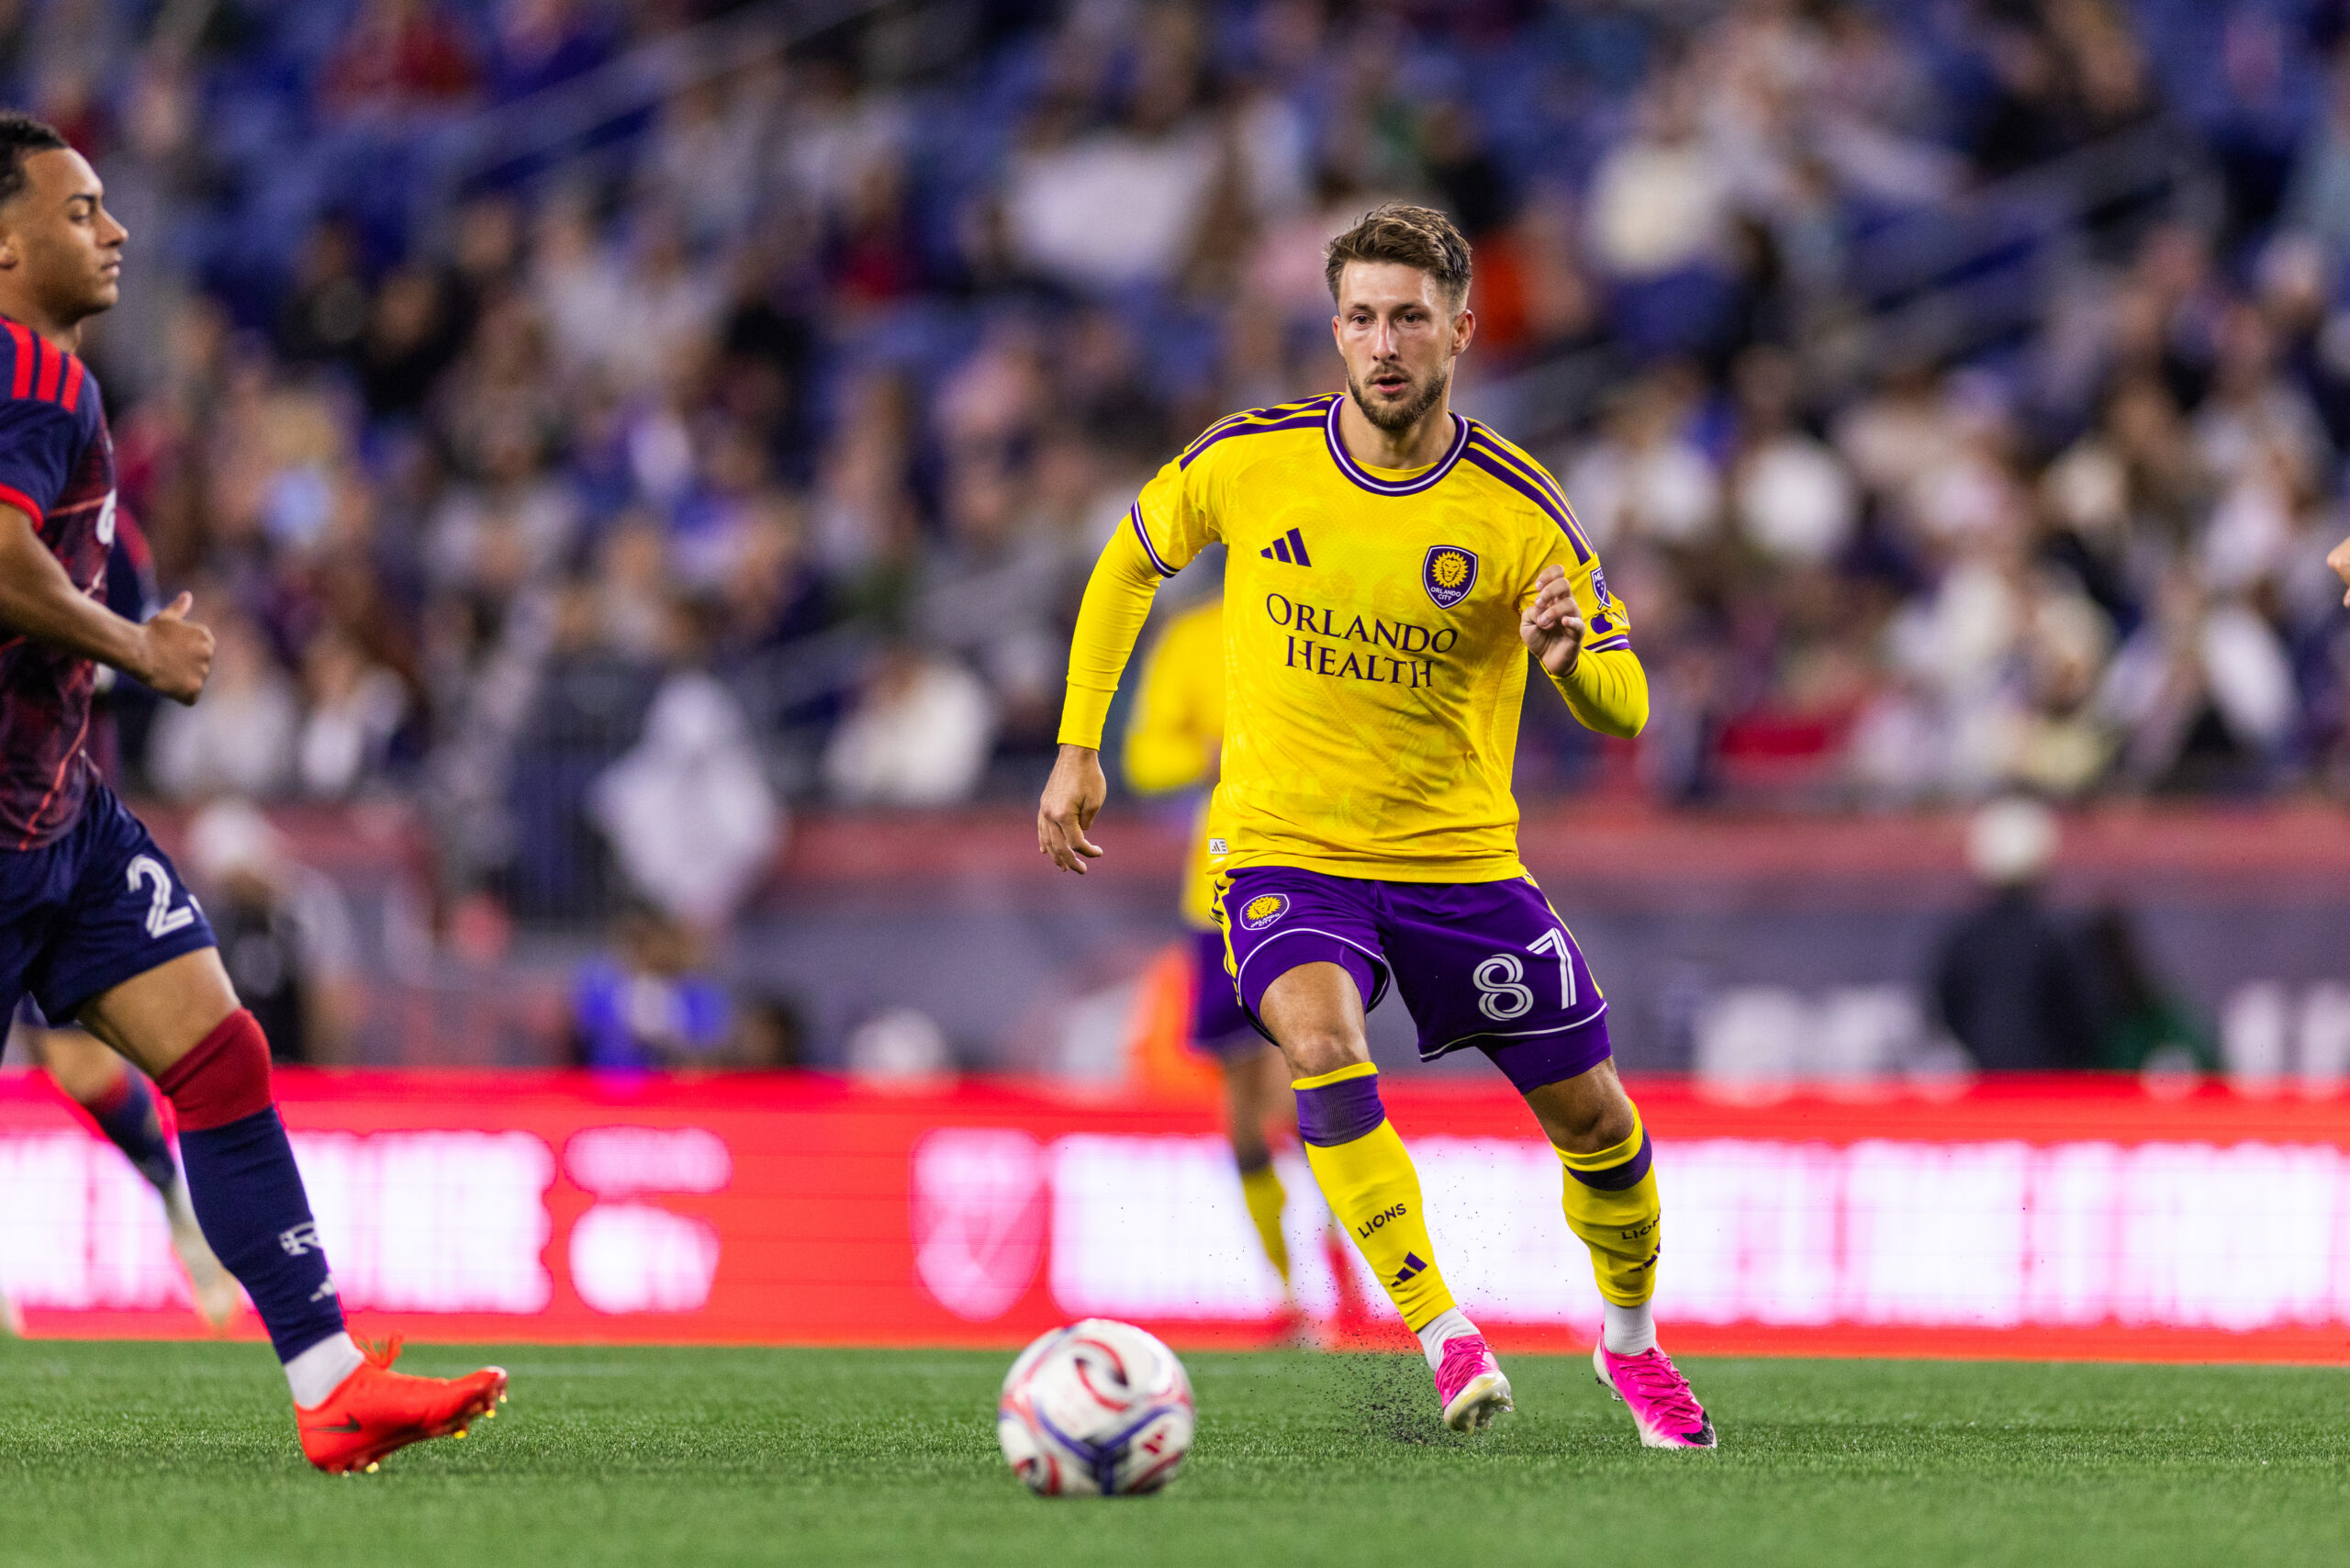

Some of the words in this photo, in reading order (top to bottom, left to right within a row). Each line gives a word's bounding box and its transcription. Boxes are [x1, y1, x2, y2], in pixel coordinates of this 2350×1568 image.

[1430, 587, 1461, 598] ORLANDO
[1266, 593, 1459, 654] ORLANDO
[1285, 634, 1436, 689] HEALTH
[1472, 927, 1577, 1022] 87
[1357, 1203, 1407, 1239] LIONS
[1621, 1206, 1661, 1240] LION
